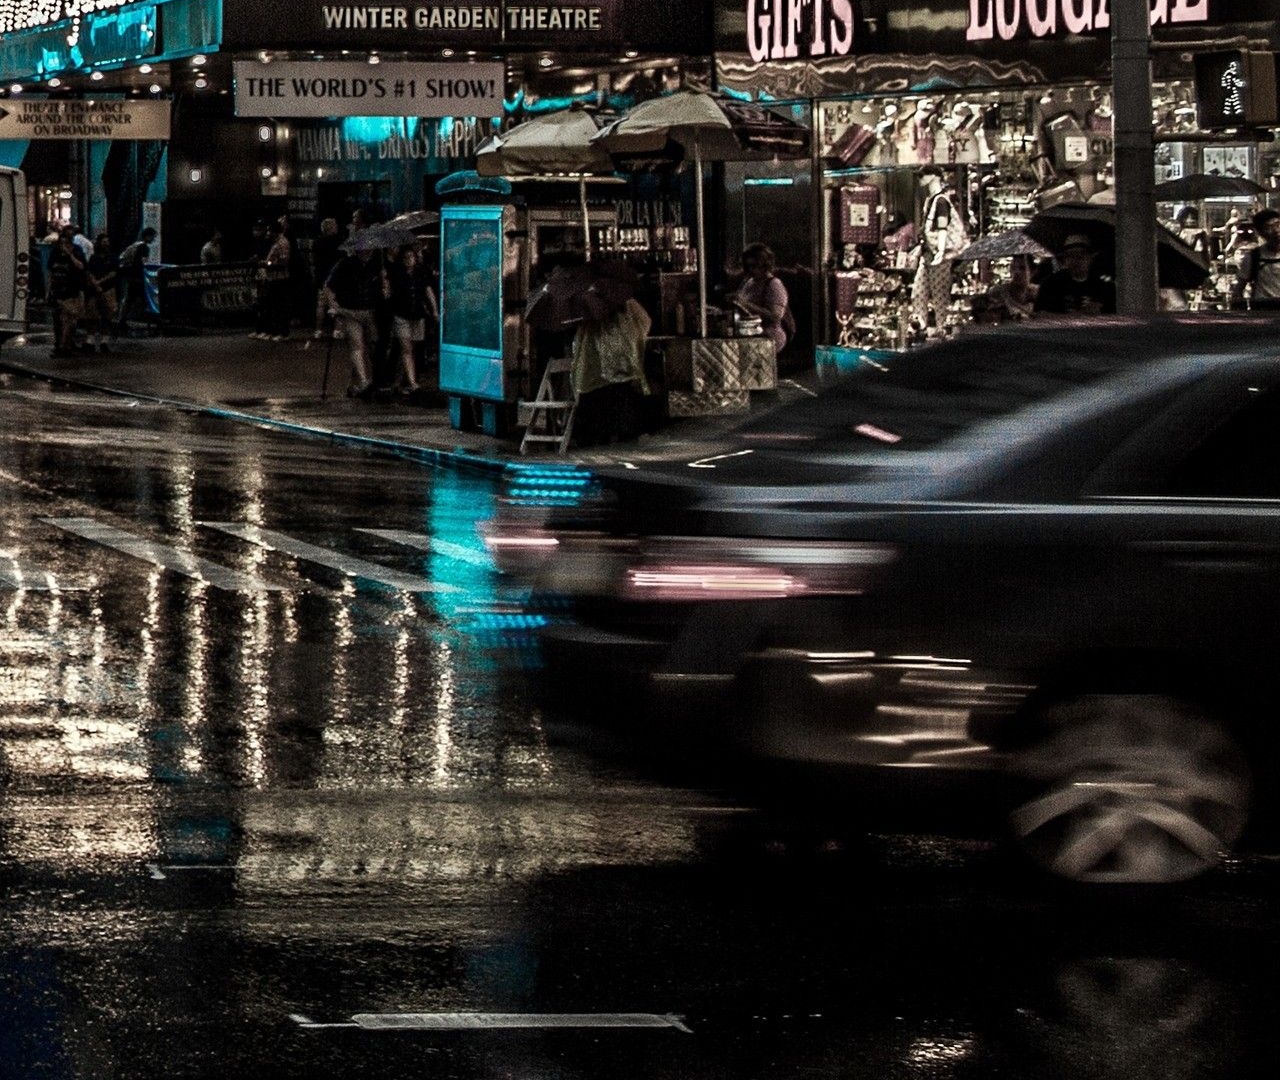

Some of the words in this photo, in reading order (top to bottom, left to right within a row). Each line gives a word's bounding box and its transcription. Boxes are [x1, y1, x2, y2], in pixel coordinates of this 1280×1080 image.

[322, 6, 408, 29] WINTER
[414, 7, 499, 30] GARDEN
[507, 7, 602, 30] THEATRE
[245, 77, 286, 98] THE
[292, 77, 386, 99] WORLD'S
[393, 77, 417, 98] #1
[426, 77, 496, 99] SHOW!
[16, 113, 62, 124] AROUND
[65, 114, 84, 124] THE
[87, 113, 132, 124] CORNER
[34, 125, 51, 136] ON
[53, 125, 113, 136] BROADWAY
